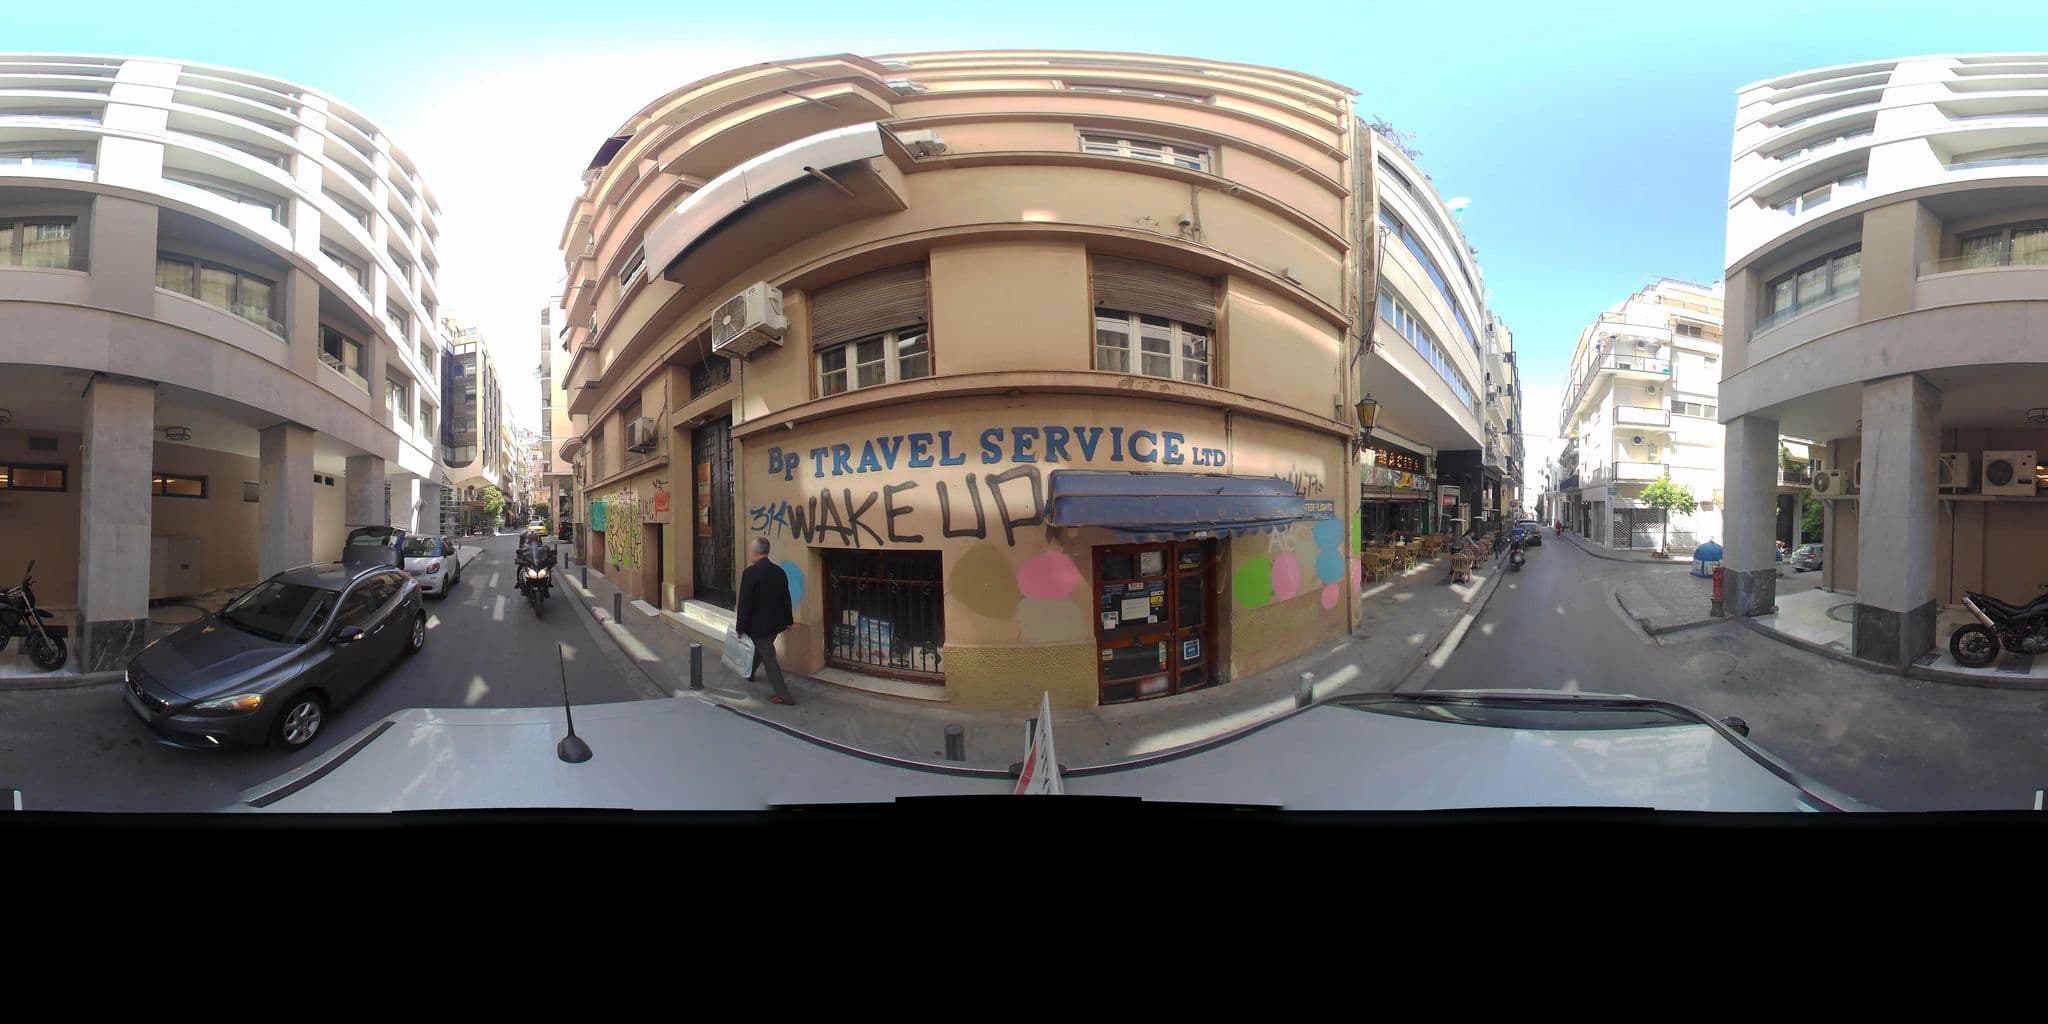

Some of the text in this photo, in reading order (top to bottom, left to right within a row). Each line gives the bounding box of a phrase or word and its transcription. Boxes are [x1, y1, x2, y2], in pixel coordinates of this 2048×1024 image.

[810, 430, 966, 478] TRAVEL
[980, 425, 1186, 466] SERVICE
[1191, 447, 1226, 467] LTD
[786, 464, 1046, 548] WAKE UP
